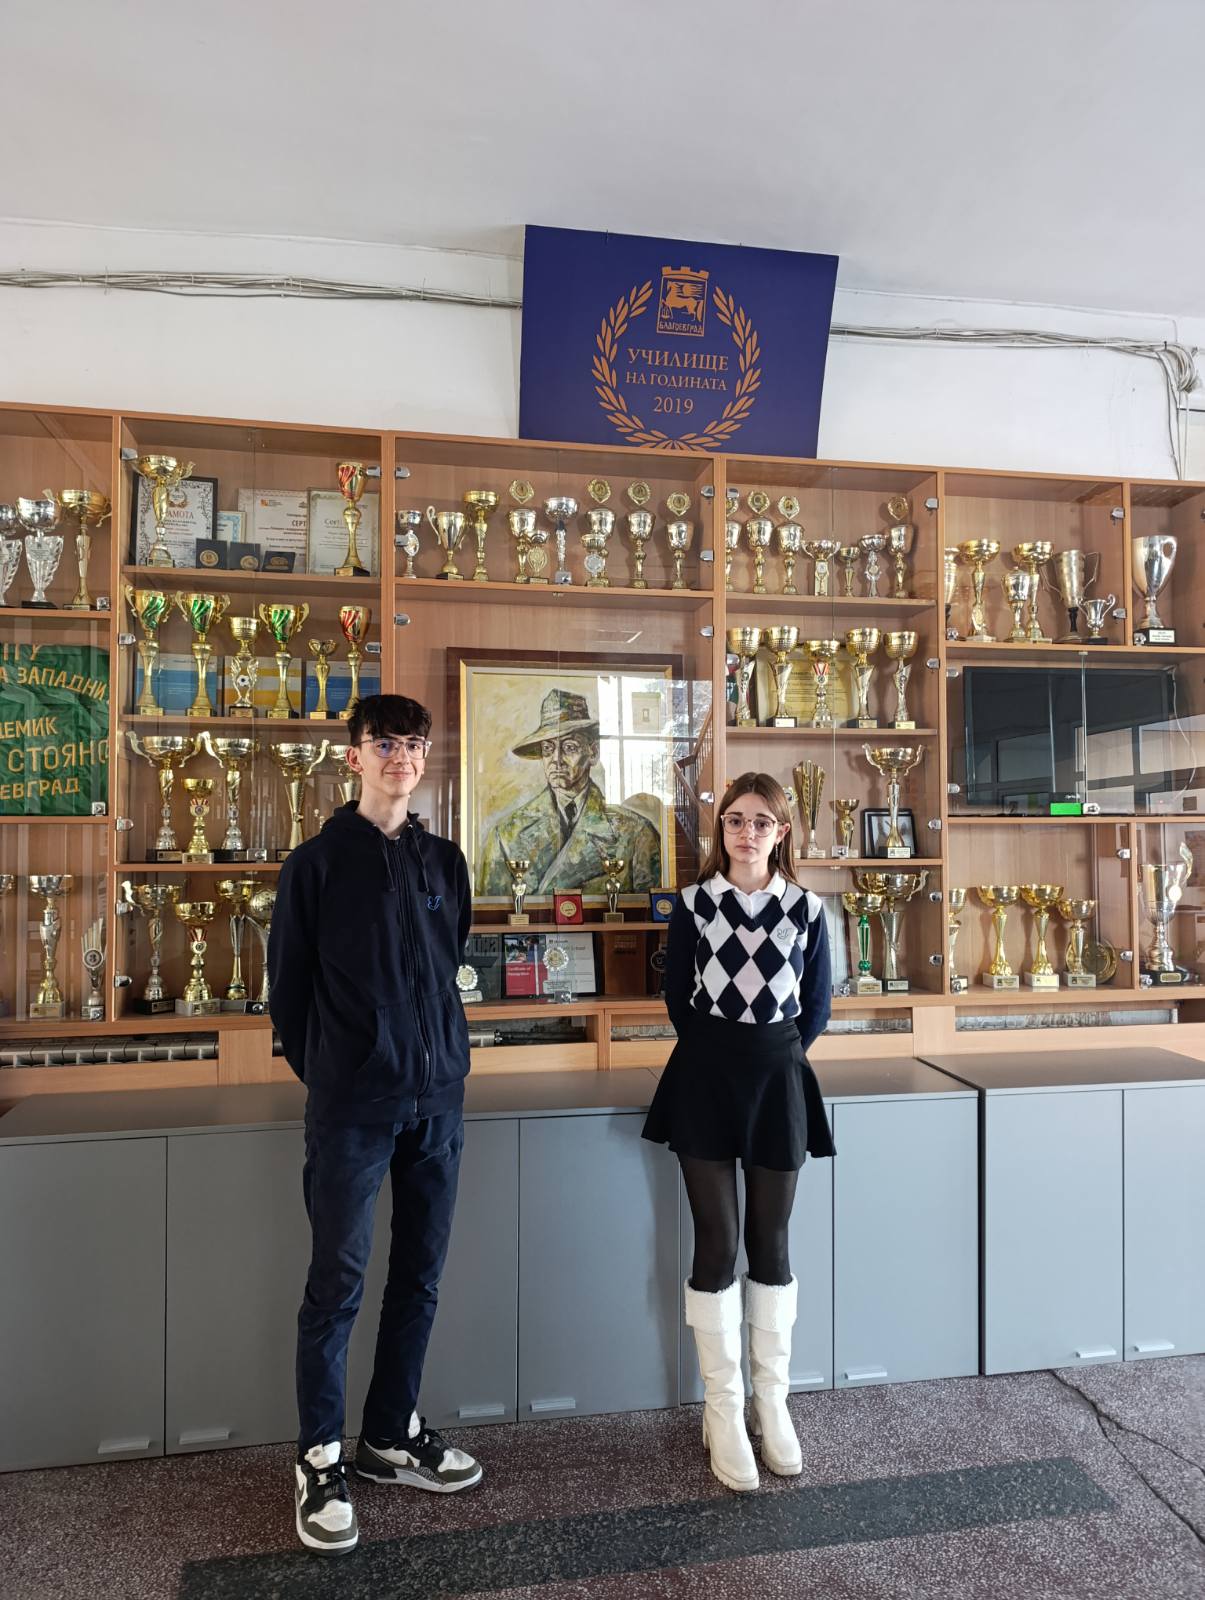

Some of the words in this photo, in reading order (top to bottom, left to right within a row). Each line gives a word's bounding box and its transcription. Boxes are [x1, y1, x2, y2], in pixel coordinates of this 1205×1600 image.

[627, 348, 729, 376] УЧИЛИЩЕ
[625, 371, 647, 385] НА
[650, 373, 728, 391] ГОДИНАТА
[653, 396, 694, 415] 2019
[17, 666, 107, 700] ЗАПАДНИ
[0, 716, 58, 739] ЕМИК
[8, 739, 109, 773] СТОЯНО
[0, 777, 80, 800] ЕВГРАД
